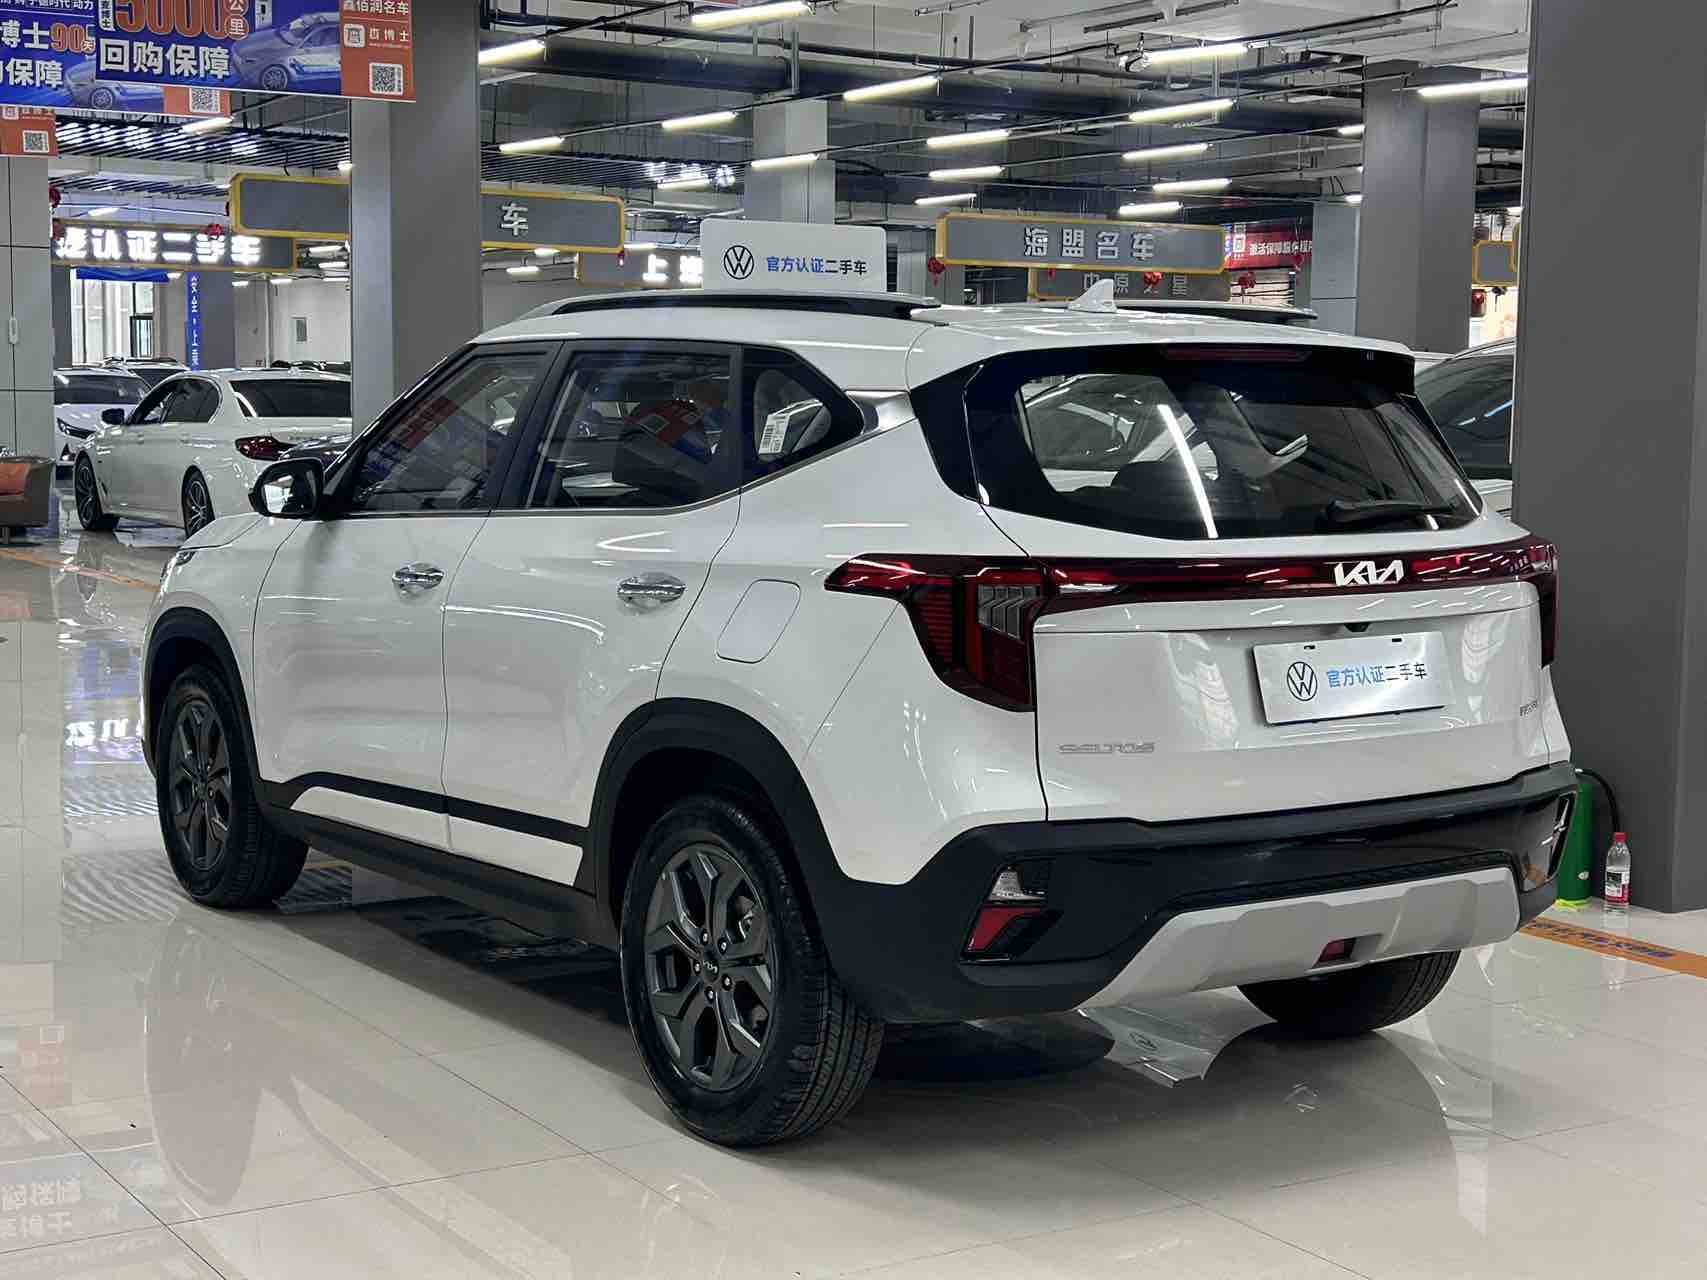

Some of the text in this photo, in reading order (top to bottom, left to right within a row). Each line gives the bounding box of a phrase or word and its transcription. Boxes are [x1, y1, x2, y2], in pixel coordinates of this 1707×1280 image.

[0, 57, 63, 88] 保障
[100, 38, 230, 79] 回购保障
[500, 203, 528, 236] 车
[1024, 227, 1155, 261] 海盟名车
[766, 256, 868, 275] 官方认证二手车
[1327, 663, 1427, 688] 官方认证二手车
